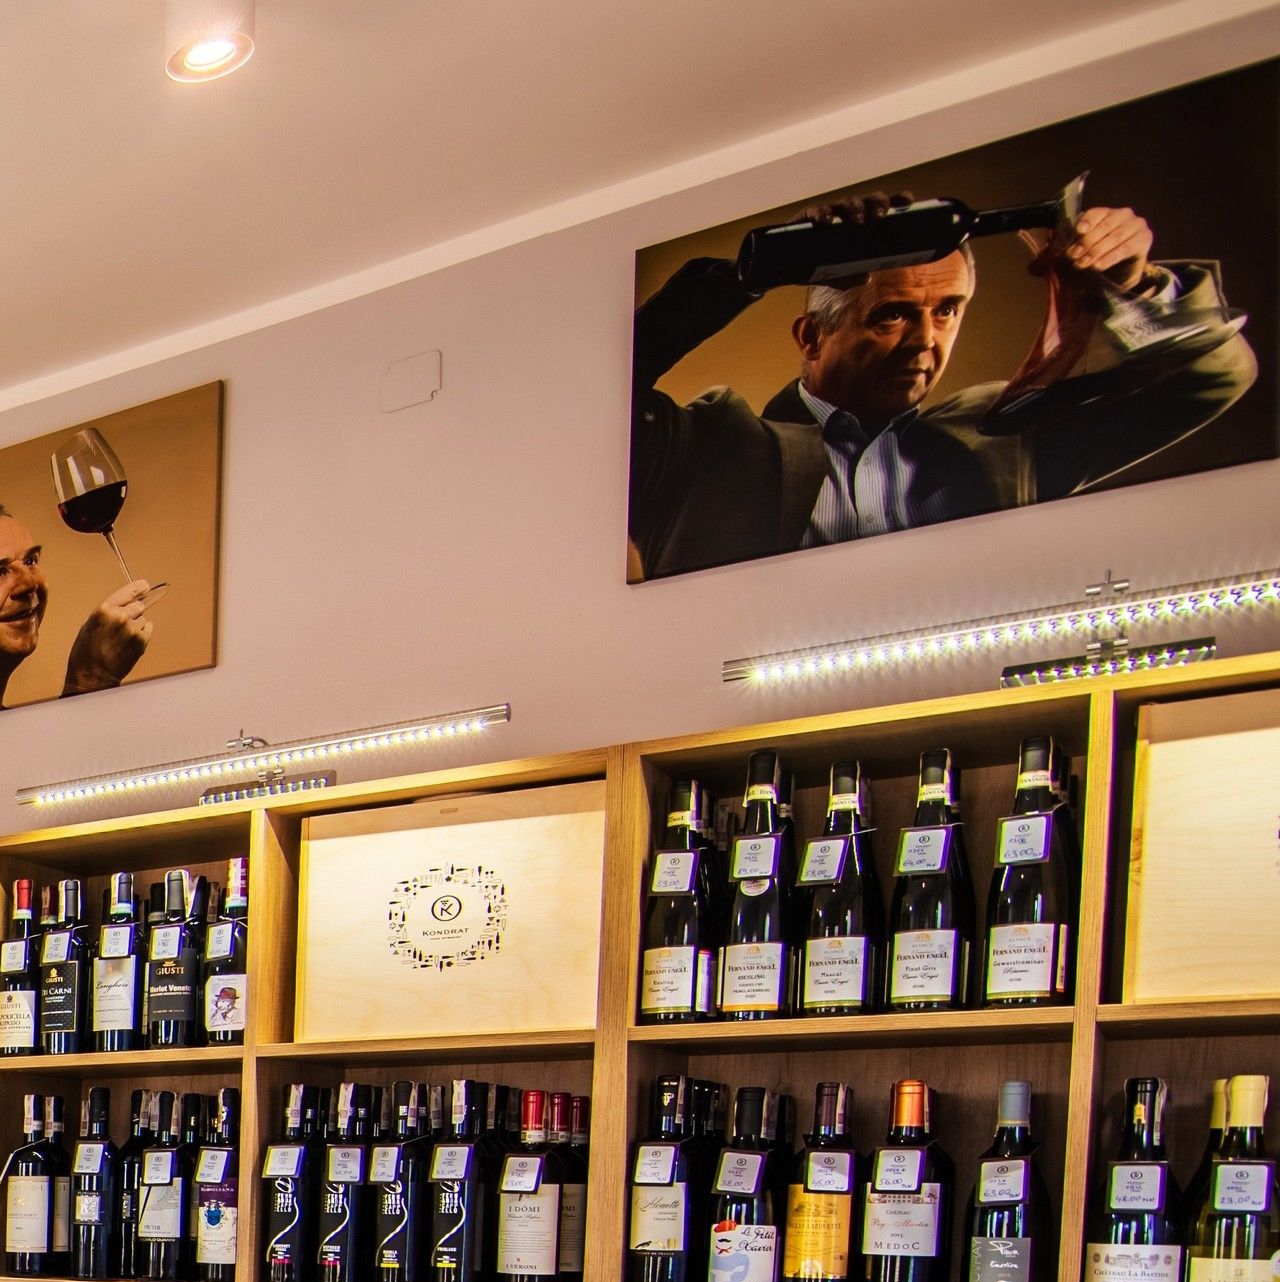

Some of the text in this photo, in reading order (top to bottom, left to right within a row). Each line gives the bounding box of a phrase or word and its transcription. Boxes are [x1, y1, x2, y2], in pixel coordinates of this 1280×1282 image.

[421, 926, 470, 938] KONDRAT
[896, 951, 950, 963] FERNAND ENGEL
[991, 945, 1049, 957] FERNAND ENGEL
[808, 957, 861, 968] FERNAND ENGEL
[155, 965, 186, 976] GIUSTI
[753, 1226, 776, 1241] Petit
[1127, 1269, 1140, 1278] LA
